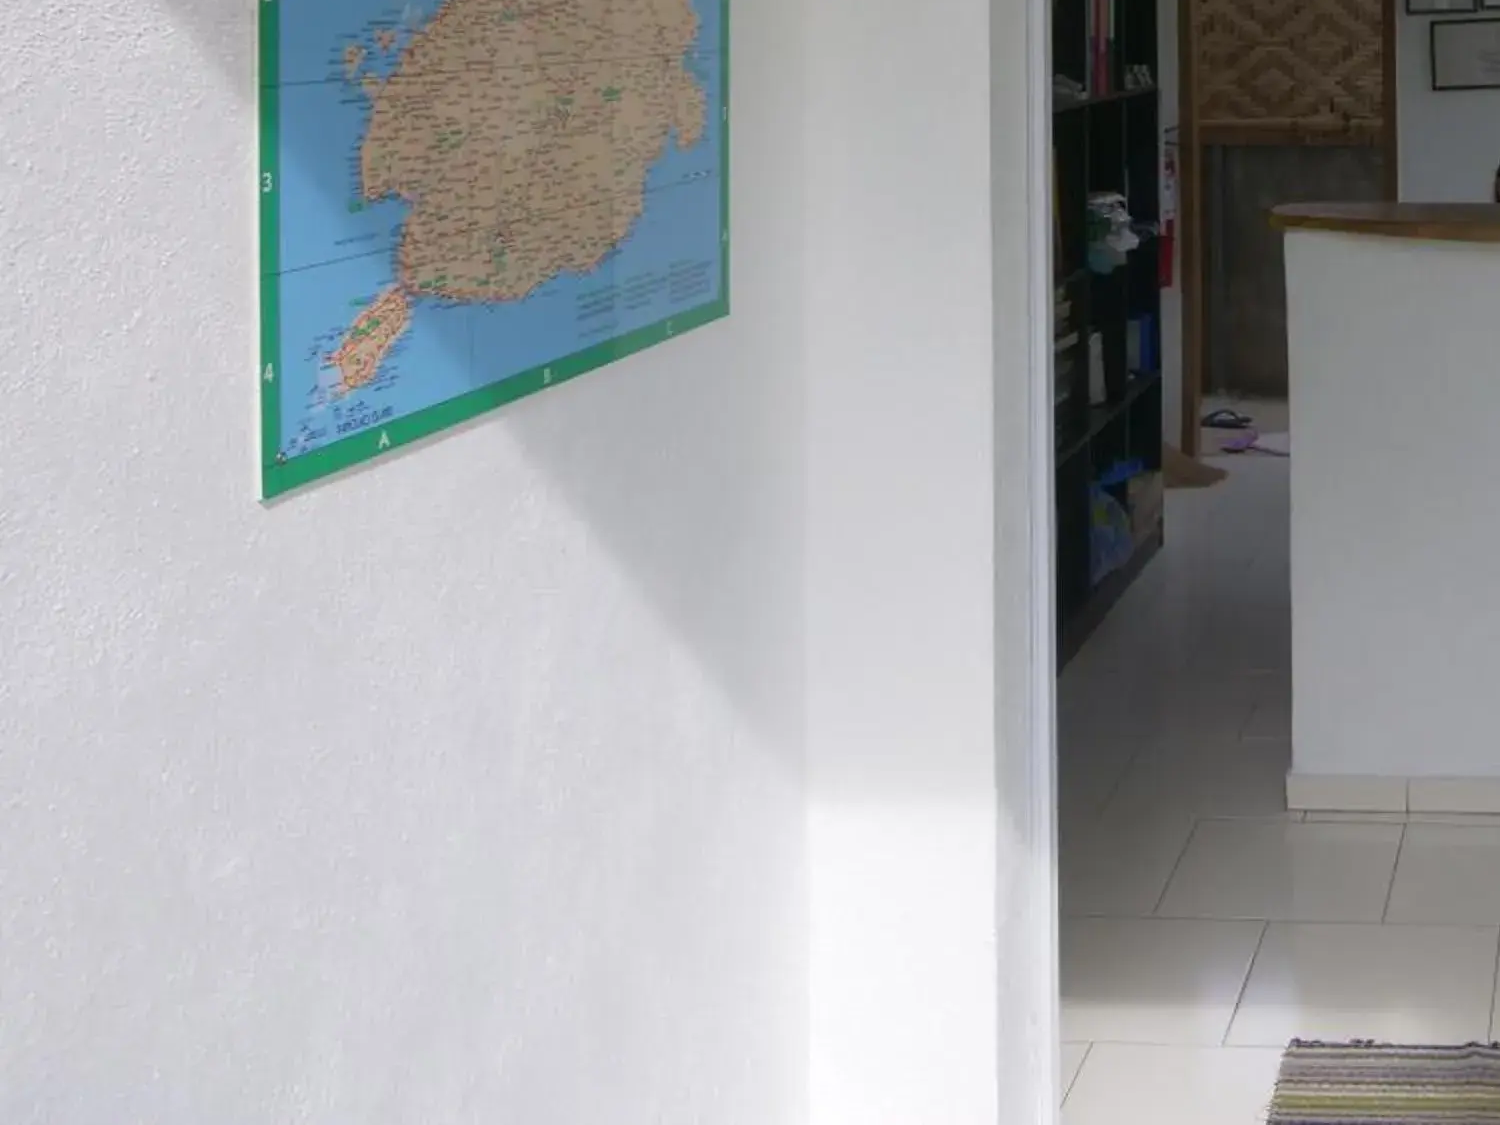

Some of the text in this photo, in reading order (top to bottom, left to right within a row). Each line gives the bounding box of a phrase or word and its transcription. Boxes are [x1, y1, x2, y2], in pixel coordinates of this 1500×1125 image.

[263, 171, 273, 193] 3
[263, 362, 273, 382] 4
[378, 429, 391, 449] A
